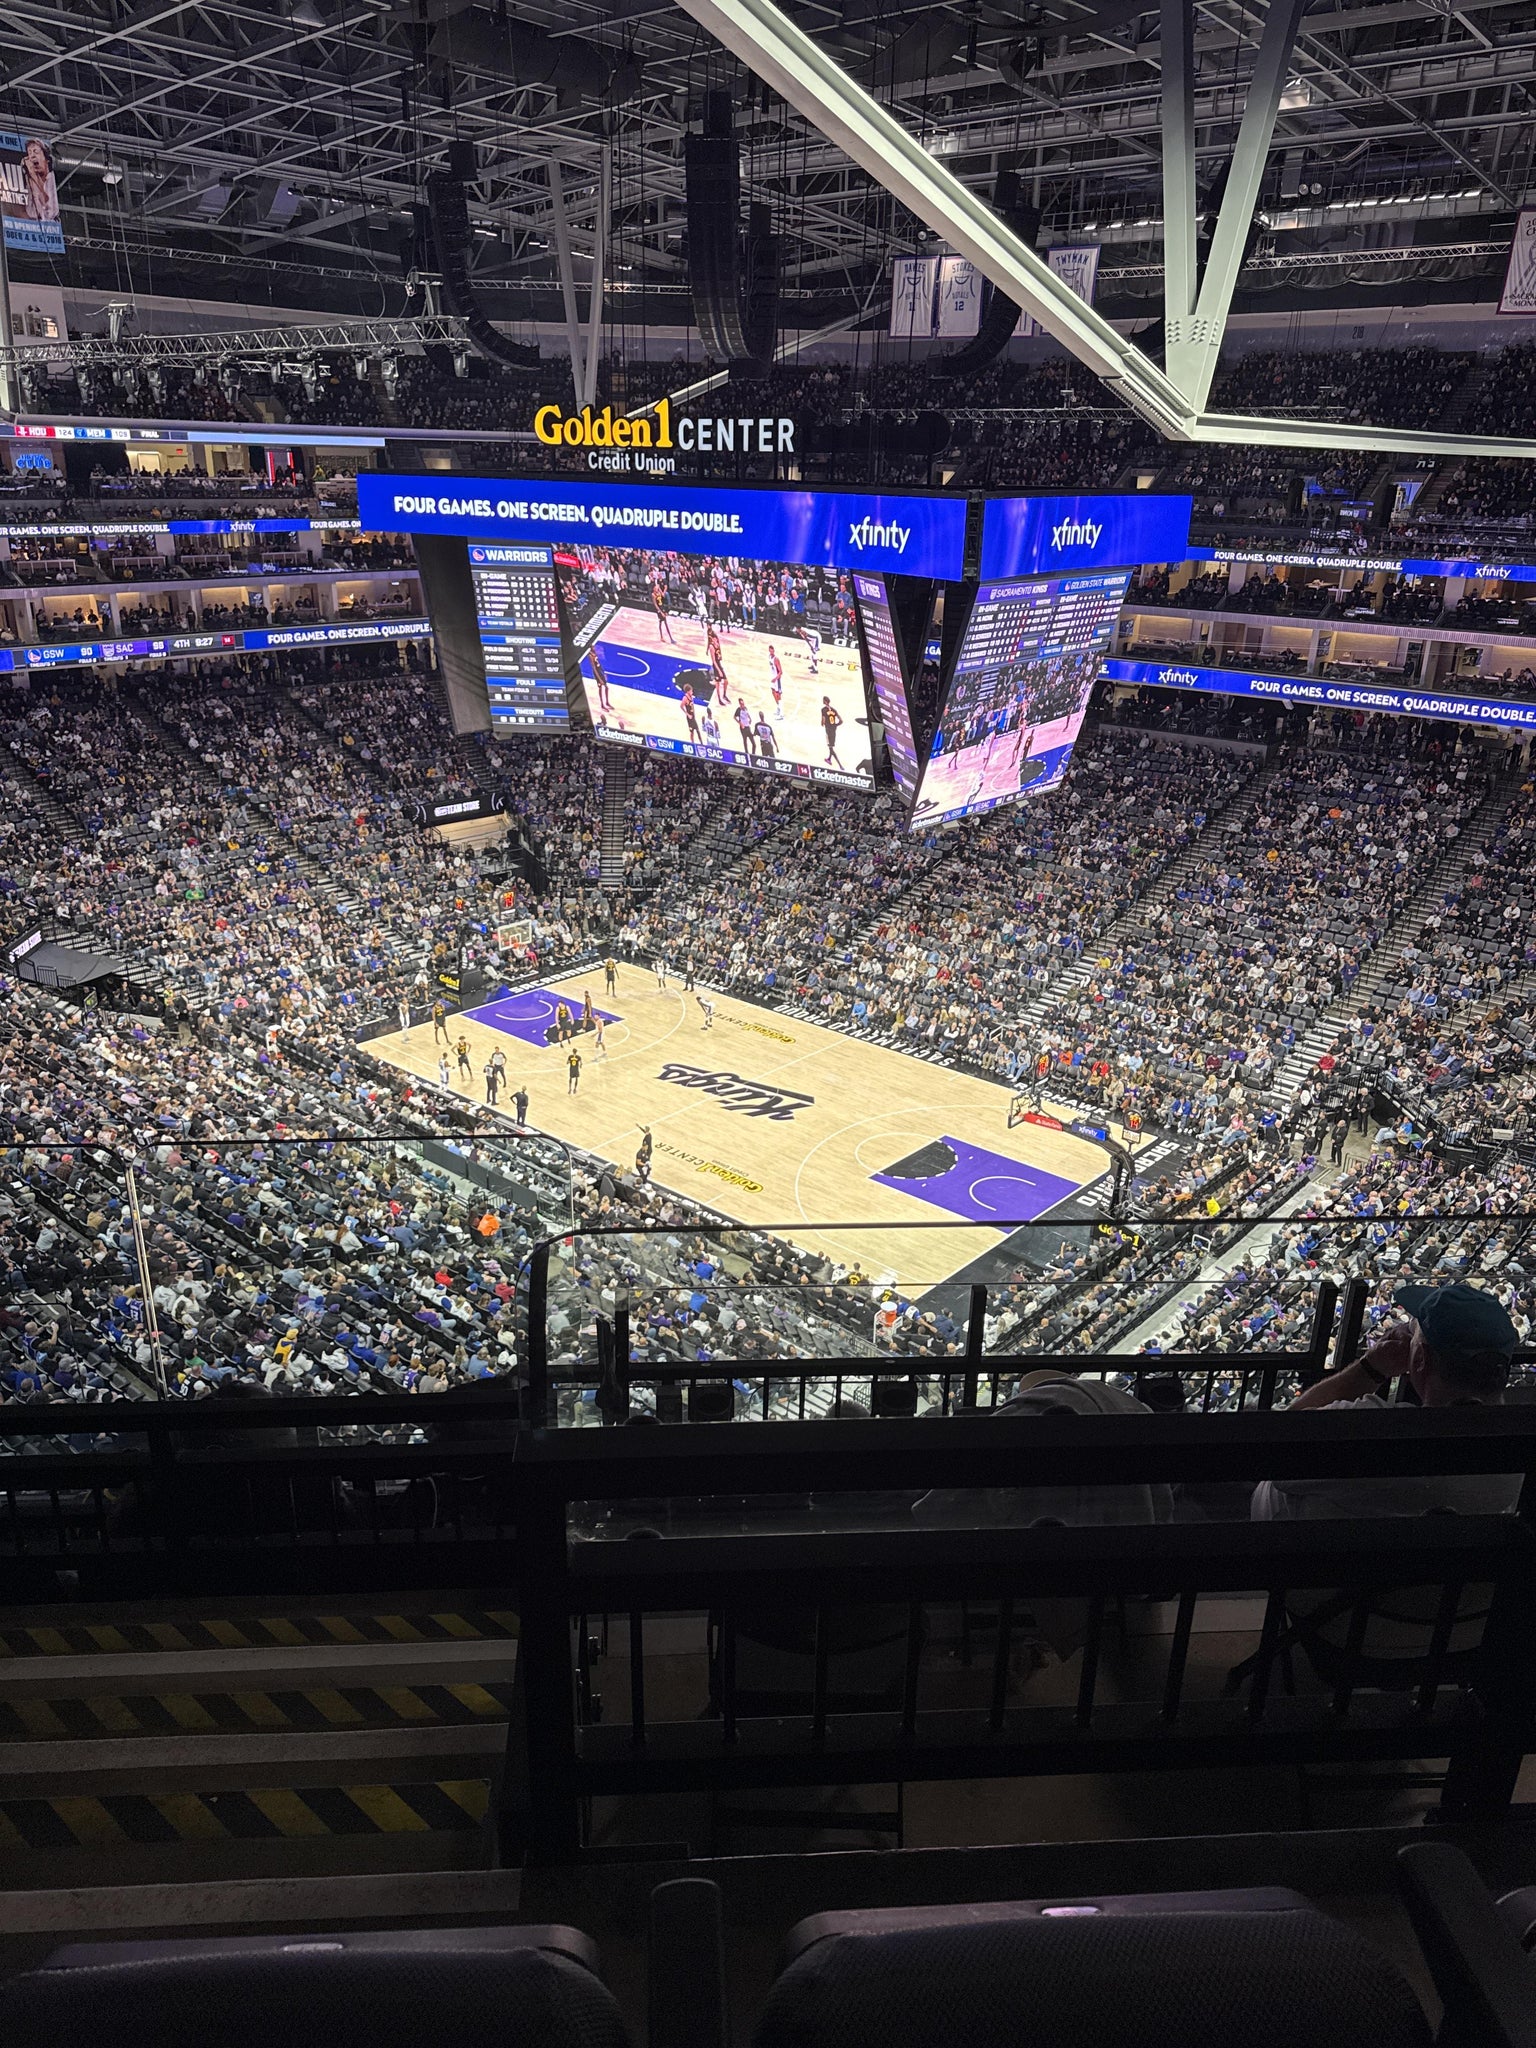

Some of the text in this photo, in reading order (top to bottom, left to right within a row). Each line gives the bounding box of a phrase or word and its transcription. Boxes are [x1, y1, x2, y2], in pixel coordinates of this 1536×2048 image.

[1056, 253, 1089, 266] TWYMAN
[955, 301, 964, 311] 12
[29, 427, 46, 436] HOU
[59, 429, 72, 437] 124
[678, 418, 794, 454] CENTER
[588, 451, 675, 472] Credit Union
[394, 496, 744, 533] FOUR GAMES. ONE SCREEN. QUADRUPLE DOUBLE.
[9, 526, 41, 535] GAMES.
[42, 526, 59, 535] ONE
[60, 525, 91, 534] SCREEN.
[92, 525, 138, 535] QUADRUPLE
[139, 524, 170, 533] DOUBLE.
[230, 520, 256, 532] xfinity
[310, 520, 361, 529] FOUR GAMES. ON
[1051, 516, 1103, 551] xfinity
[849, 515, 911, 554] xfinity
[485, 550, 548, 563] WARRIORS
[1214, 551, 1403, 571] FOUR GAMES. ONE SCREEN. QUADRUPLE DOUBLE.
[1475, 565, 1511, 579] xfinity
[996, 585, 1048, 598] SACRAMENTO KINGS
[1071, 580, 1090, 590] GOLDEN
[1103, 576, 1126, 586] WARRIORS
[268, 623, 430, 645] FOUR GAMES. ONE SCREEN. QUADRUPLE
[573, 603, 616, 648] SACRAMENTO
[43, 649, 64, 659] GSW
[115, 643, 133, 653] SAC
[174, 639, 190, 648] 4TH
[1158, 670, 1198, 687] xfinity
[1251, 681, 1281, 695] FOUR
[1283, 683, 1324, 699] GAMES.
[1327, 688, 1351, 702] ONE
[1353, 690, 1401, 707] SCREEN.
[1402, 696, 1478, 716] QUADRUPLE
[598, 727, 644, 744] ticketmaster
[658, 739, 674, 750] GSW
[683, 744, 693, 754] 90
[707, 748, 723, 759] SAC
[756, 758, 769, 769] 4th
[814, 768, 872, 788] ticketmaster
[981, 801, 990, 809] SAC
[654, 1063, 815, 1120] Kings
[1079, 1124, 1098, 1137] xfinity
[655, 1142, 764, 1193] CENTER Golden1
